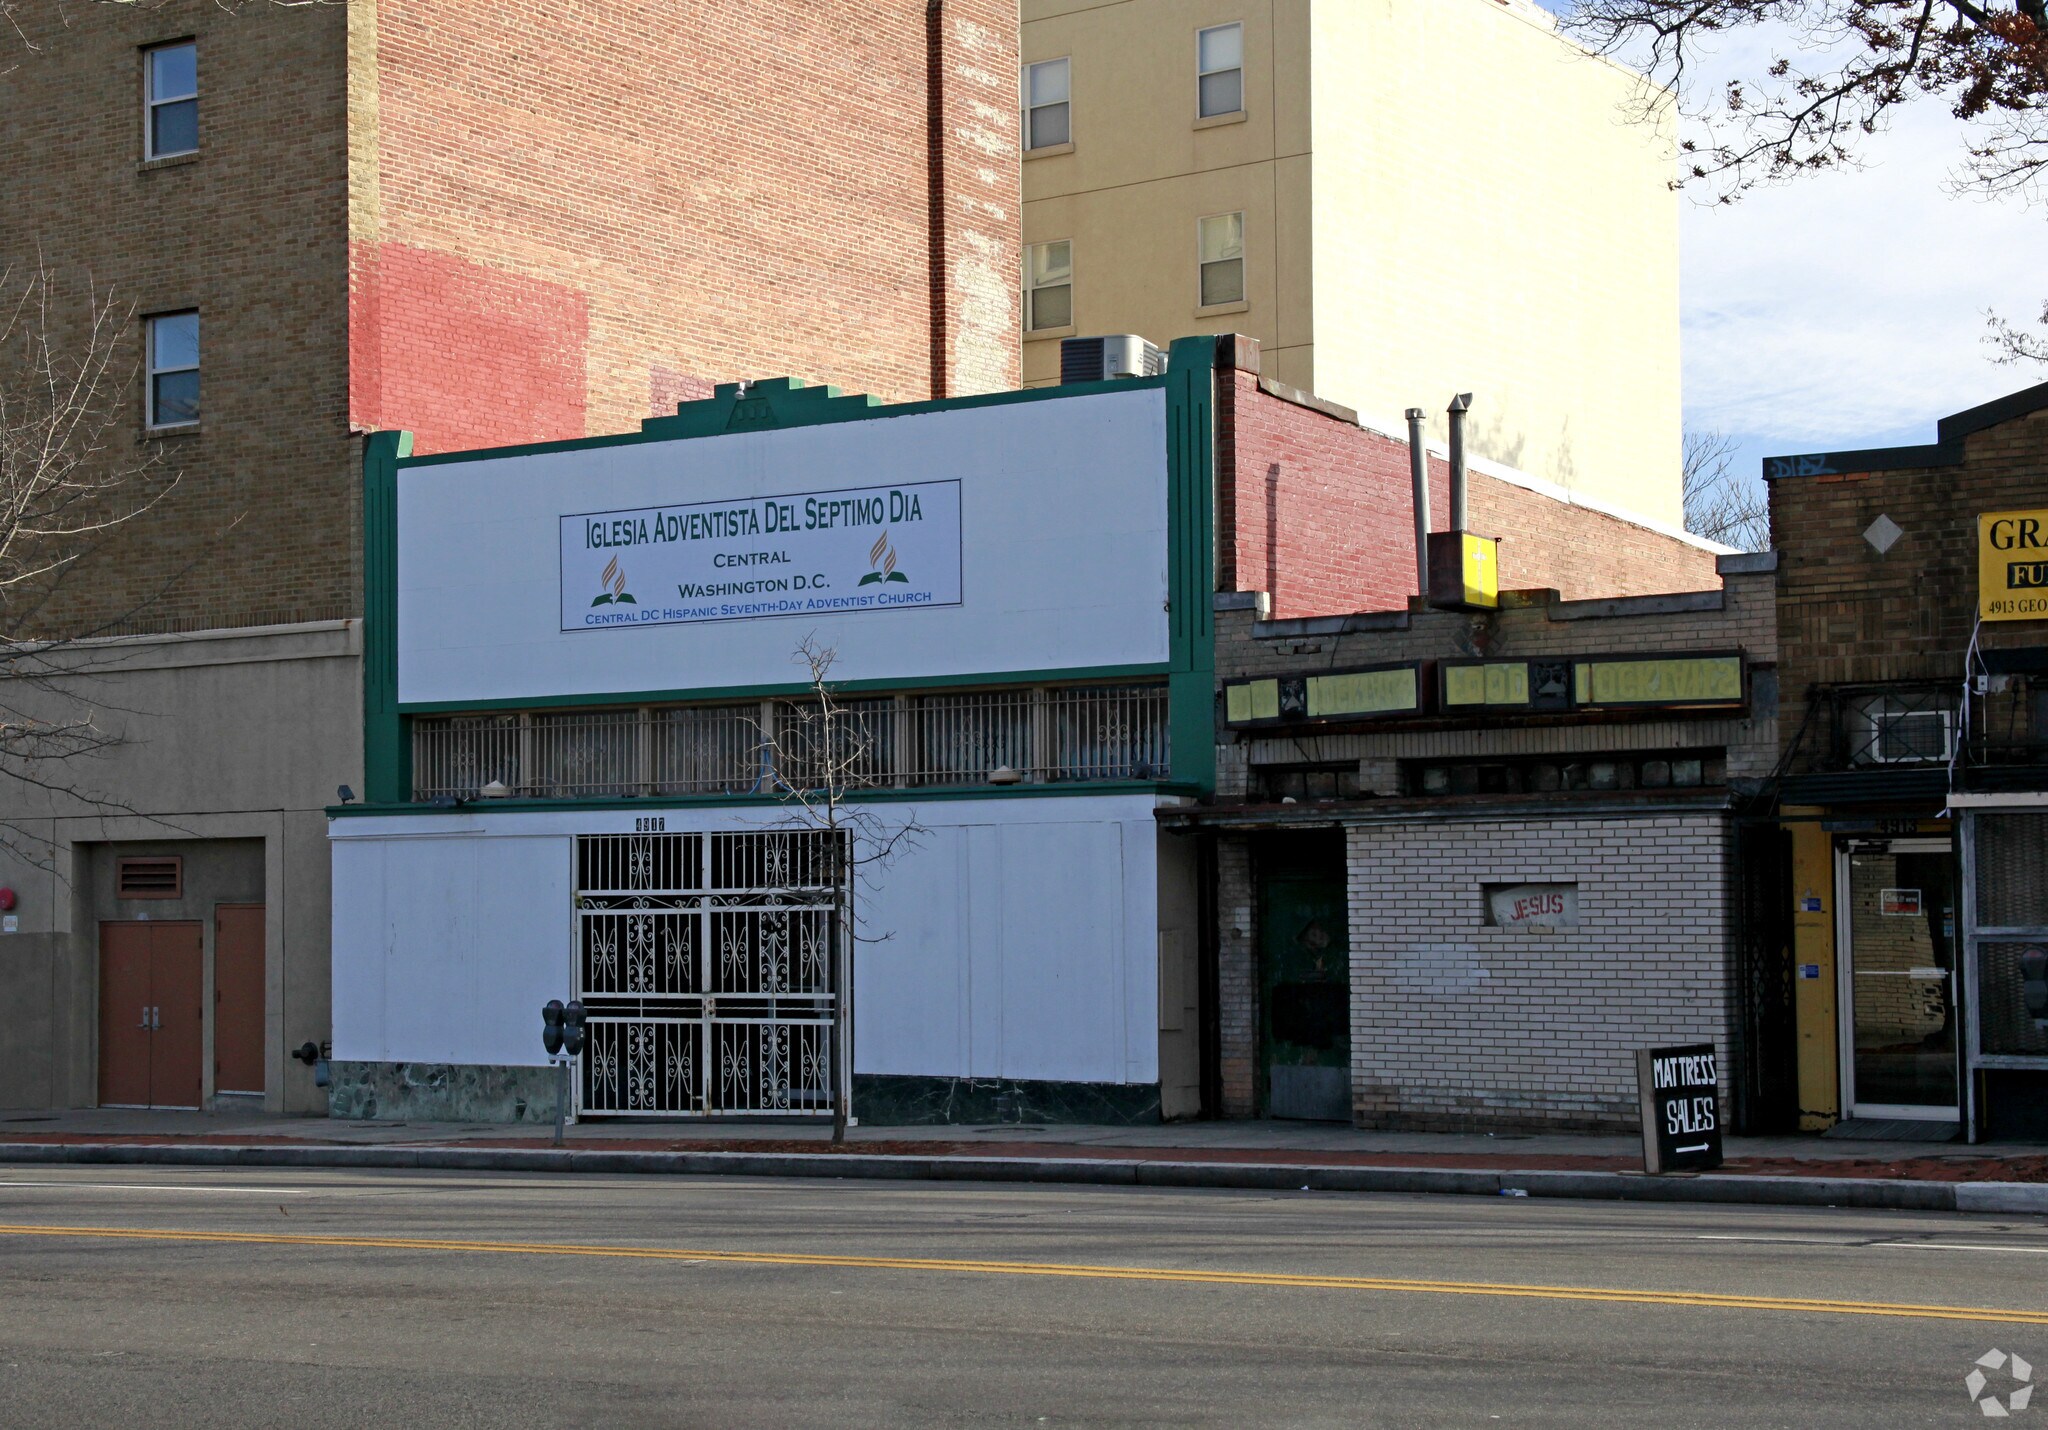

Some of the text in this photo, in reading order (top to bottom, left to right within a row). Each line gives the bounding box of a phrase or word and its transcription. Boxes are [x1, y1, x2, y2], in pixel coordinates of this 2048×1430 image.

[586, 490, 923, 549] IGLESIA ADVENTISTA DEL SEPTIMO DIA
[1989, 518, 2048, 550] GR
[713, 551, 791, 568] CENTRAL
[678, 573, 830, 598] WASHINGTON D.C.
[2012, 564, 2048, 586] FU
[585, 591, 932, 625] CENTRAL DC HISPANIC SEVENTH-DAY ADVENTIST CHURCH
[1989, 600, 2014, 614] 4913
[636, 817, 665, 831] 4917
[1511, 894, 1564, 921] JESUS
[1653, 1055, 1716, 1089] MATTRESS
[1667, 1097, 1715, 1135] SALES
